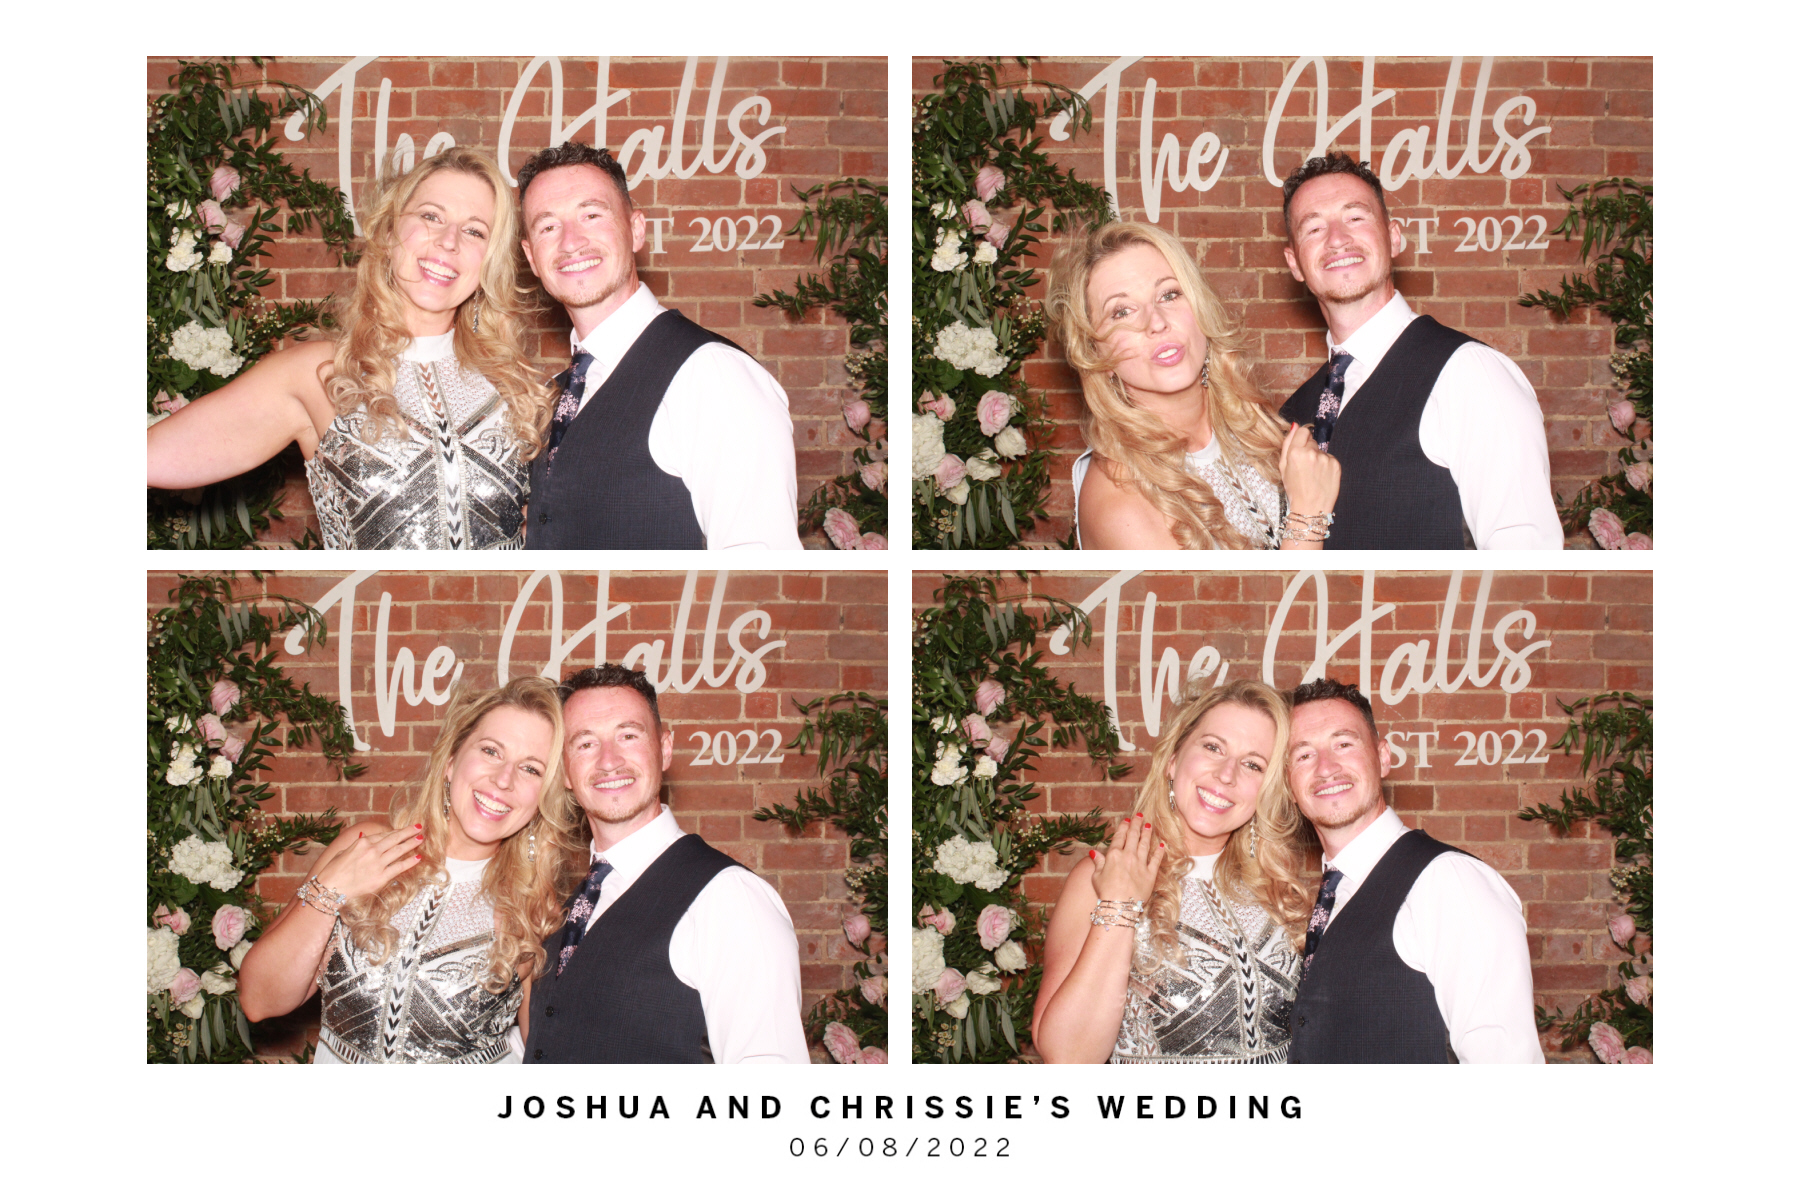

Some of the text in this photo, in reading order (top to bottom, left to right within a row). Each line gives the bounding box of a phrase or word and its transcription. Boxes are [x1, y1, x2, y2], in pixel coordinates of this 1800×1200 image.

[498, 56, 787, 192] Halls
[1049, 56, 1551, 224] The Halls
[688, 214, 785, 253] 2022
[1453, 214, 1550, 253] 2022
[284, 570, 464, 752] The
[1263, 570, 1551, 706] Halls
[688, 728, 785, 767] 2022
[1453, 728, 1550, 767] 2022
